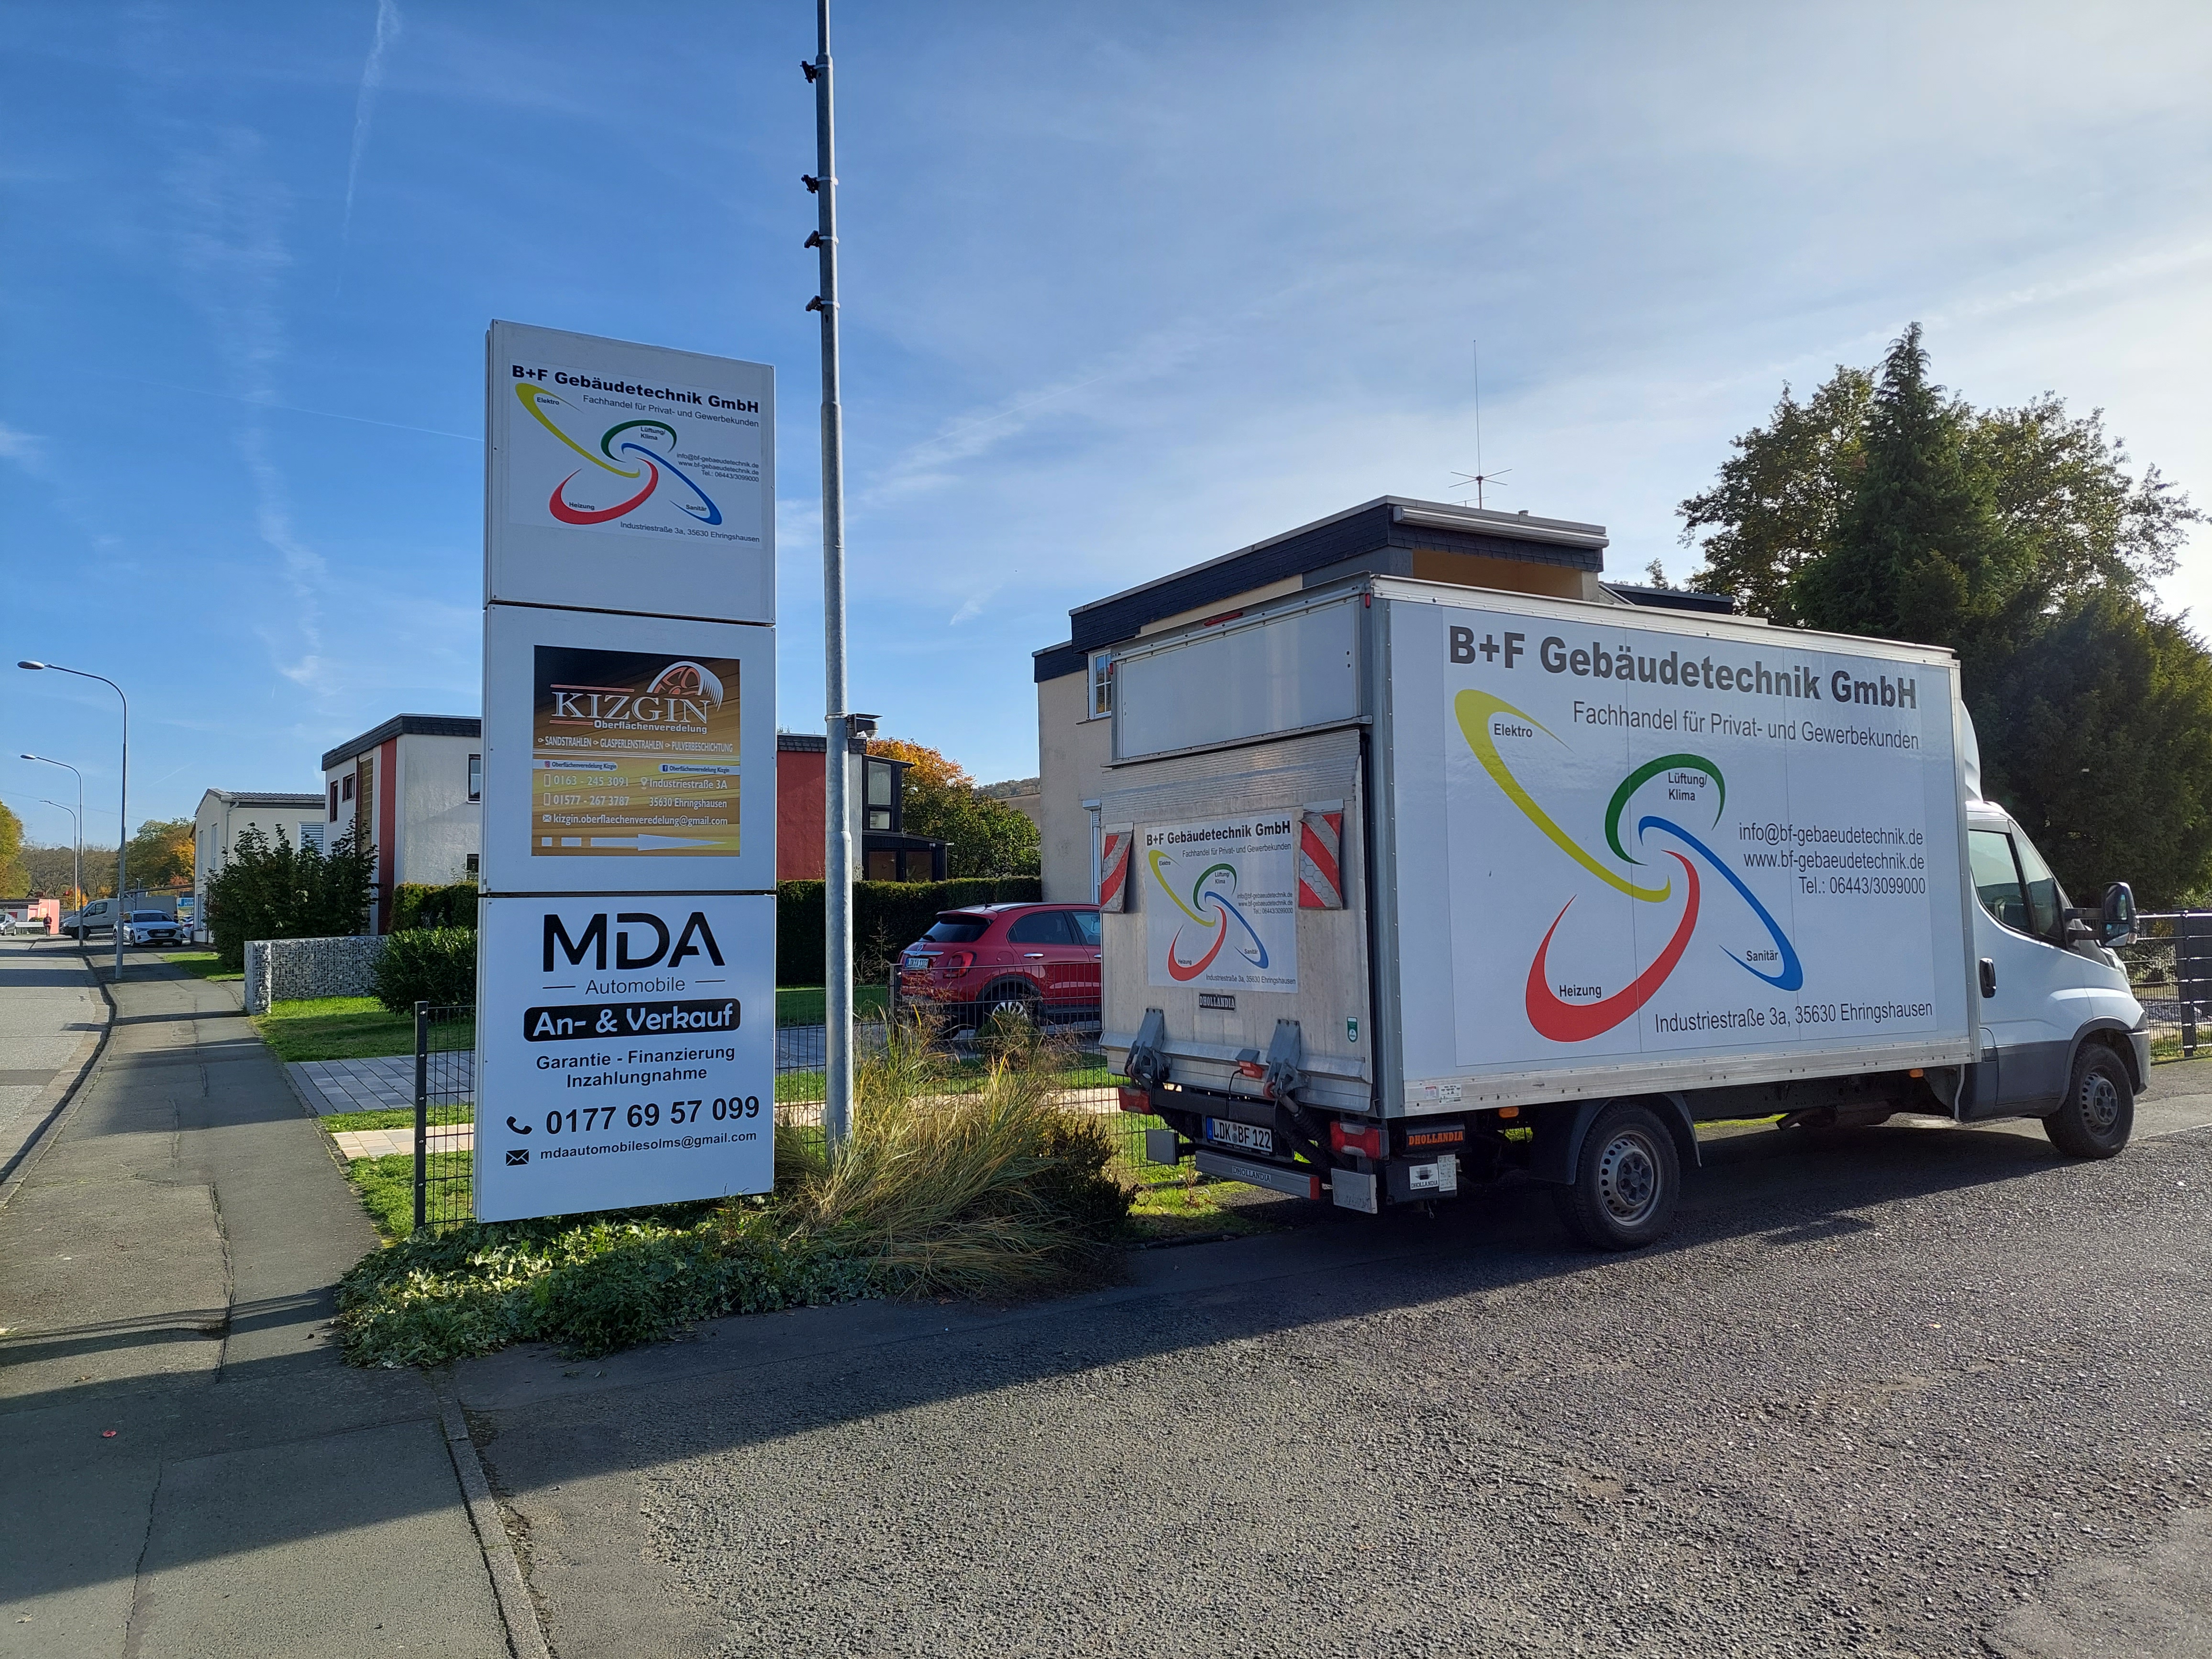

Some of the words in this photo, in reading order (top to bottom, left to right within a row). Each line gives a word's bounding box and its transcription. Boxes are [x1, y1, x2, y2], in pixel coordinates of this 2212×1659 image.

[512, 365, 548, 381] B+F
[554, 371, 703, 405] Gebäudetechnik
[708, 395, 759, 414] GmbH
[537, 397, 560, 405] Elektro
[583, 394, 633, 409] Fachhandel
[635, 402, 647, 411] für
[648, 404, 675, 415] Privat-
[677, 409, 692, 418] und
[695, 411, 759, 428] Gewerbekunden
[640, 426, 665, 435] Lüftung/
[640, 432, 658, 441] Klima
[676, 452, 759, 469] info@bf-gebaeudetechnik.de
[678, 461, 759, 476] www.bf-gebaeudetechnik.de
[715, 472, 759, 482] 06443/3099000
[569, 501, 595, 511] Heizung
[686, 504, 707, 512] Sanitär
[620, 521, 673, 533] Industriestraße
[675, 527, 686, 535] 3a,
[687, 529, 709, 537] 35630
[710, 531, 760, 543] Ehringshausen
[1449, 625, 1525, 669] B+F
[1540, 636, 1822, 701] Gebäudetechnik
[1831, 670, 1917, 709] GmbH
[551, 691, 711, 724] KIZGIN
[593, 719, 708, 734] Oberflächenveredelung
[1493, 723, 1533, 738] Elektro
[1573, 700, 1677, 731] Fachhandel
[1683, 709, 1705, 733] für
[1711, 712, 1763, 737] Privat-
[1769, 720, 1796, 741] und
[1801, 721, 1919, 750] Gewerbekunden
[544, 736, 592, 747] SANDSTRAHLEN
[600, 738, 664, 750] GLASPERLENSTRAHLEN
[671, 741, 733, 752] PULVERBESCHICHTUNG
[552, 762, 603, 770] Oberflächenveredelung
[669, 765, 716, 774] Oberflächenveredelung
[553, 775, 577, 785] 0163
[587, 776, 604, 786] 245
[608, 777, 629, 787] 3091
[650, 778, 714, 789] Industriestraße
[716, 780, 728, 789] 3A
[1668, 772, 1707, 788] Lüftung/
[553, 795, 581, 805] 01577
[589, 795, 606, 806] 267
[608, 796, 630, 806] 3787
[1669, 788, 1696, 801] Klima
[649, 797, 673, 807] 35630
[674, 797, 727, 810] Ehringshausen
[553, 814, 728, 827] kizgin.oberflaechenveredelung@gmail.com
[1147, 833, 1164, 846] B+F
[1167, 824, 1252, 844] Gebäudetechnik
[1255, 820, 1291, 836] GmbH
[1739, 822, 1924, 846] info@bf-gebaeudetechnik.de
[1182, 848, 1210, 858] Fachhandel
[1219, 846, 1235, 855] Privat-
[1236, 845, 1246, 853] und
[1247, 842, 1291, 853] Gewerbekunden
[1743, 850, 1924, 873] www.bf-gebaeudetechnik.de
[1798, 876, 1825, 895] Tel.:
[1830, 876, 1926, 895] 06443/3099000
[543, 911, 725, 972] MDA
[1746, 949, 1779, 962] Sanitär
[585, 977, 686, 995] Automobile
[1206, 974, 1237, 983] Industriestraße
[1261, 977, 1296, 985] Ehringshausen
[1559, 984, 1603, 999] Heizung
[1199, 995, 1235, 1008] DHOLLANDIA
[532, 1012, 586, 1036] An-
[595, 1009, 618, 1033] &
[626, 1003, 733, 1031] Verkauf
[1655, 1007, 1765, 1034] Industriestraße
[1769, 1006, 1792, 1028] 3a,
[1794, 1004, 1836, 1025] 35630
[1840, 1000, 1933, 1024] Ehringshausen
[536, 1053, 611, 1070] Garantie
[628, 1046, 735, 1064] Finanzierung
[567, 1068, 708, 1088] Inzahlungnahme
[546, 1106, 617, 1135] 0177
[627, 1103, 660, 1128] 69
[670, 1100, 703, 1124] 57
[712, 1095, 759, 1121] 099
[1213, 1121, 1231, 1141] LDK
[1238, 1126, 1250, 1144] BF
[1252, 1128, 1271, 1150] 122
[1408, 1130, 1464, 1146] DHOLLANDIA
[540, 1131, 757, 1160] mdaautomobilesolms@gmail.com
[1233, 1167, 1271, 1182] DHOLLANDIA
[1411, 1180, 1438, 1189] DHOLLANDIA
